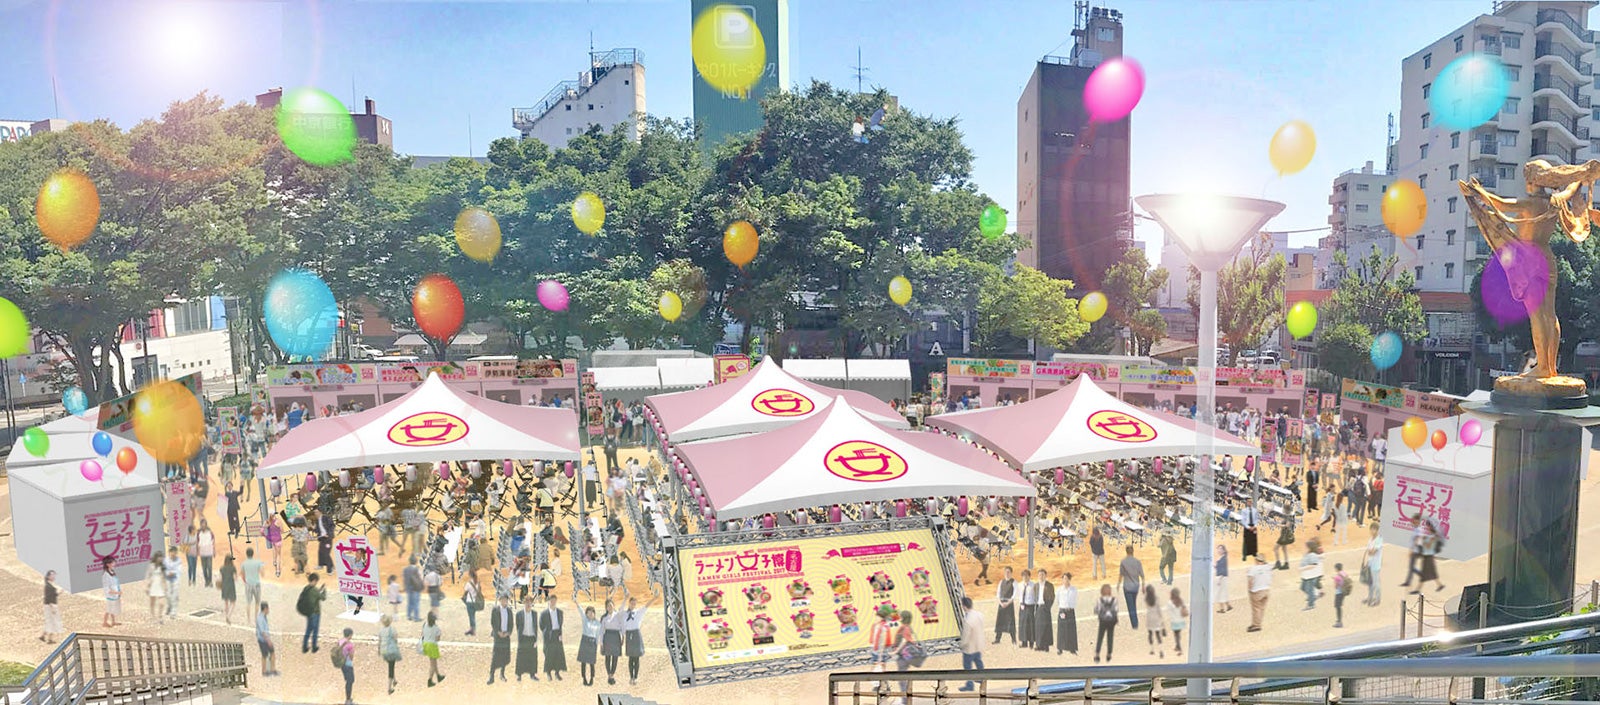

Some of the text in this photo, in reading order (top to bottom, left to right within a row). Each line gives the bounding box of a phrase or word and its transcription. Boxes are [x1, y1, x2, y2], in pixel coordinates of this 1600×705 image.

[0, 125, 31, 143] PAR
[85, 509, 150, 538] ラーメン
[120, 547, 140, 558] 2017
